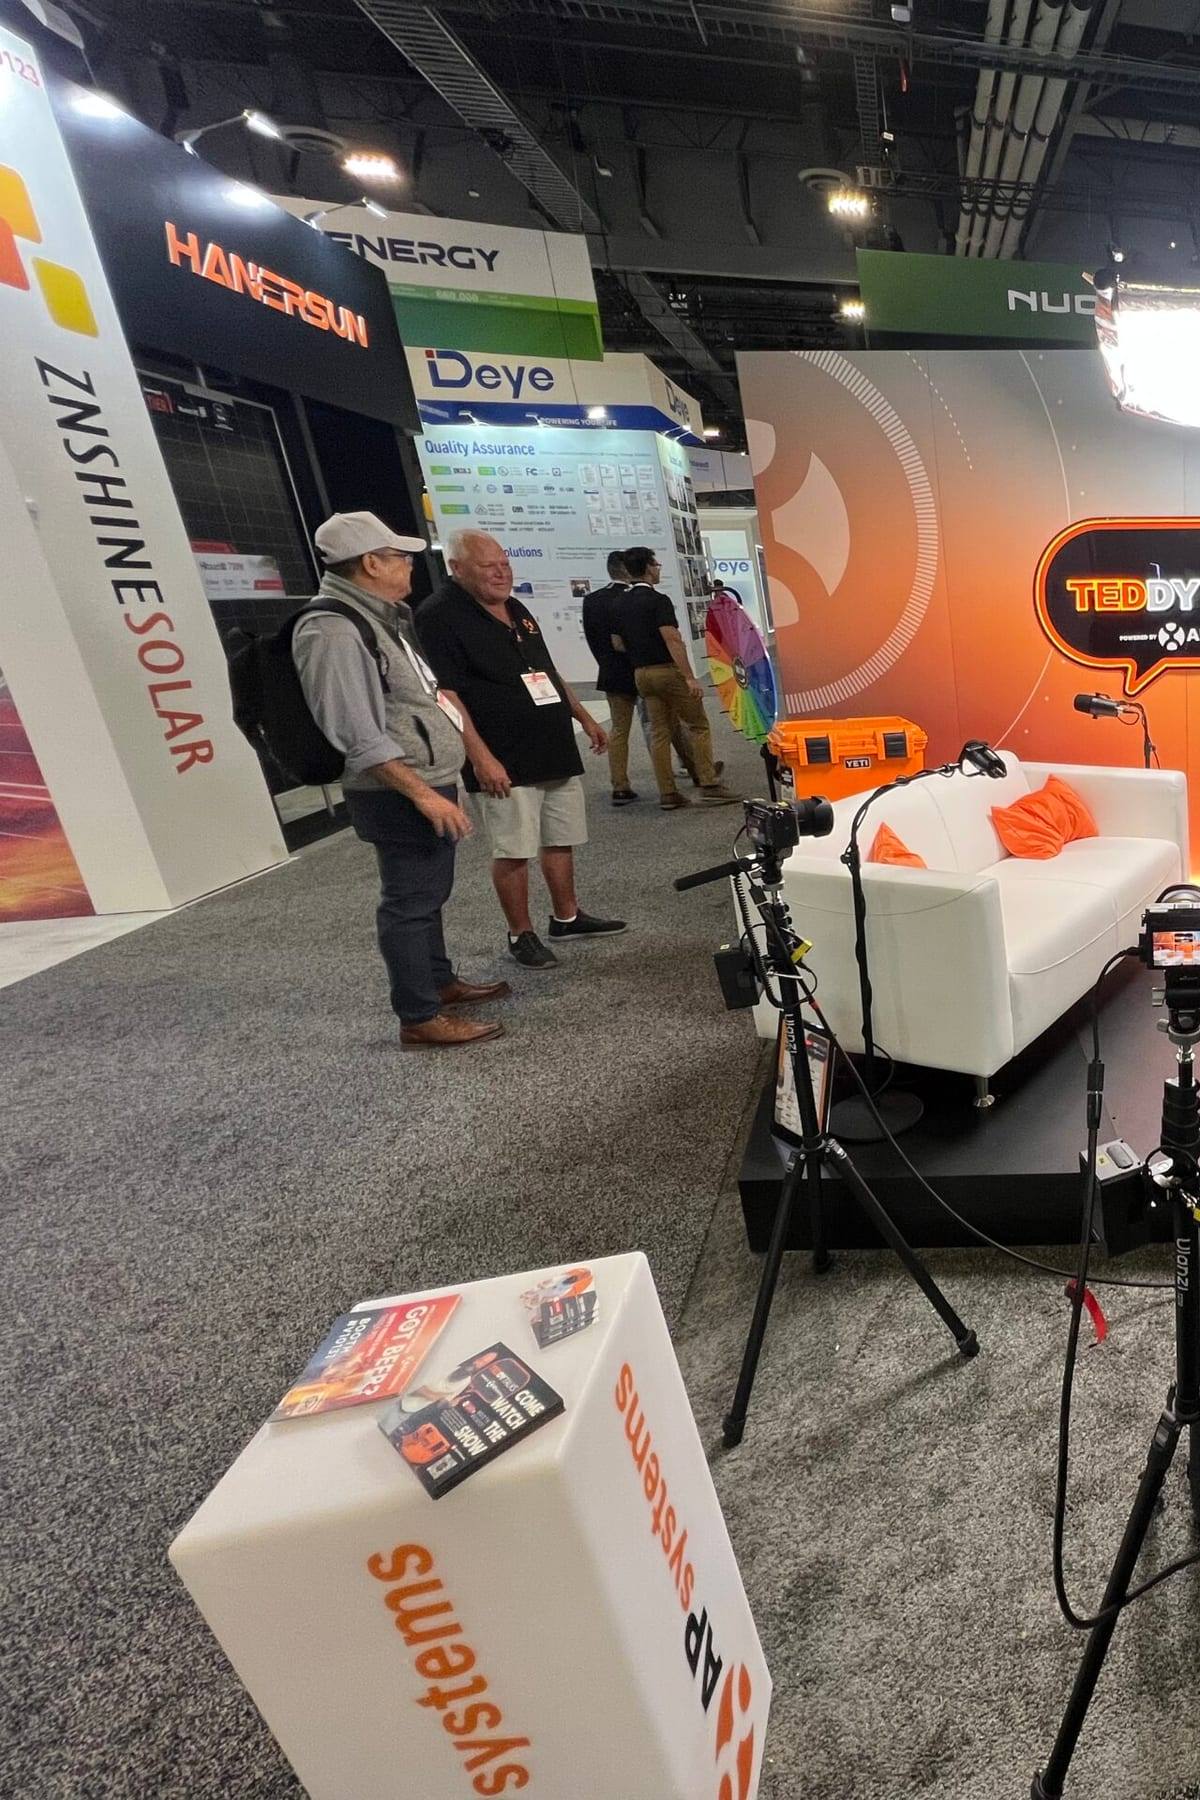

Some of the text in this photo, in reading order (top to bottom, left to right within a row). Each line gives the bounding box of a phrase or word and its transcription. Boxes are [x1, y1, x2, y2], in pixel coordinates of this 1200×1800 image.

[0, 50, 40, 87] 123
[164, 221, 369, 348] HANERSUN
[425, 439, 535, 457] Quality Assurance
[501, 546, 543, 558] olutions
[713, 560, 750, 575] eye
[1119, 634, 1149, 642] POWERED
[1150, 633, 1158, 641] BY
[845, 758, 869, 768] YETI
[340, 1317, 372, 1352] BOOTH
[391, 1305, 429, 1341] GOT
[490, 1395, 528, 1430] WATCH
[514, 1389, 545, 1417] COME
[454, 1425, 489, 1456] SHOW
[483, 1420, 508, 1443] THE
[366, 1542, 532, 1797] systems
